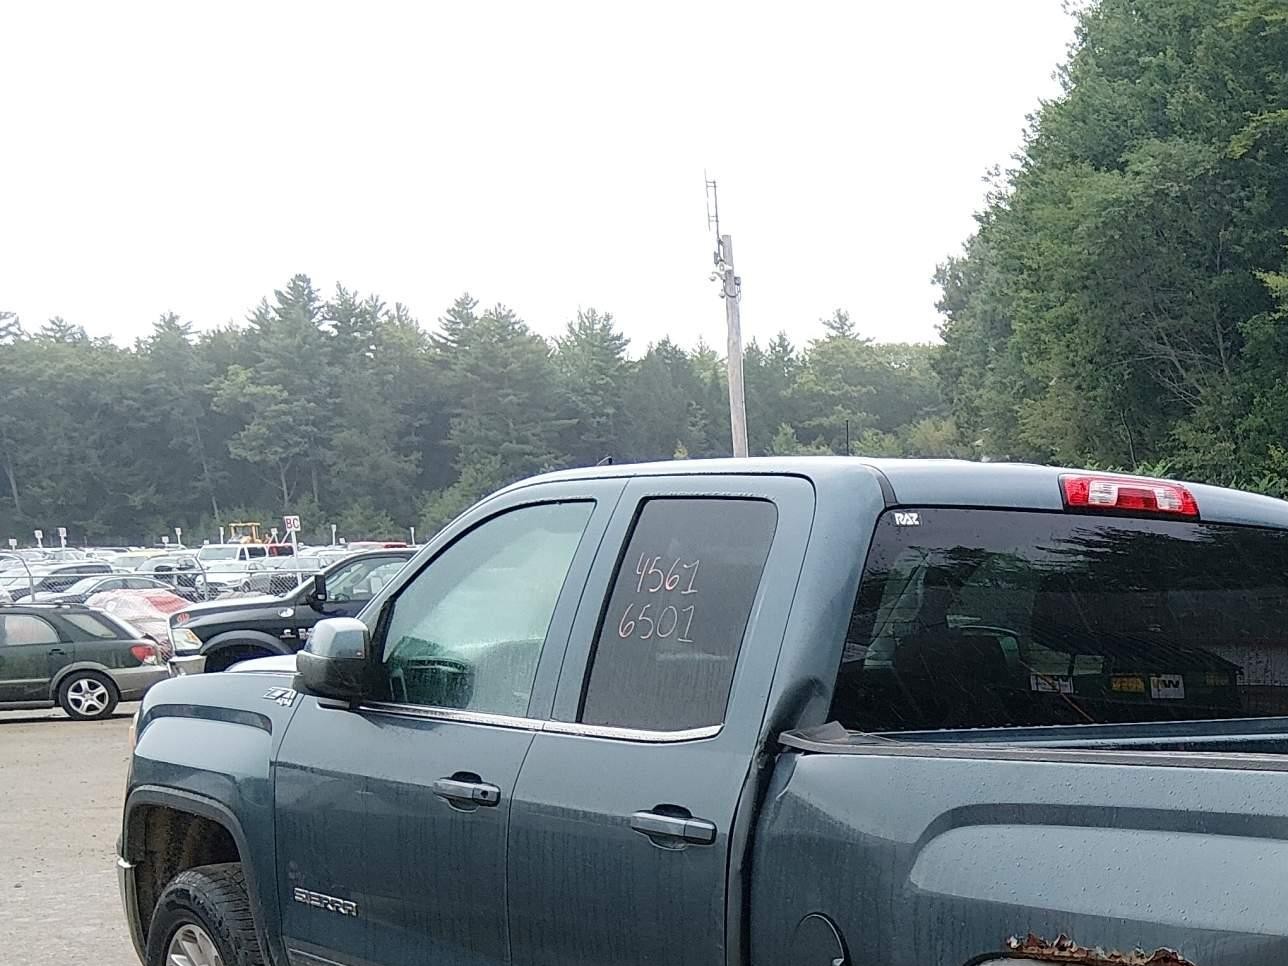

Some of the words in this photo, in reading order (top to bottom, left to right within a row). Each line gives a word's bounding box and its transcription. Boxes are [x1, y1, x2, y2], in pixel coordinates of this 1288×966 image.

[286, 518, 300, 529] BC
[895, 513, 919, 525] RAZ
[637, 552, 700, 594] 4561
[618, 603, 695, 642] 6501
[294, 887, 358, 916] SIERRA
